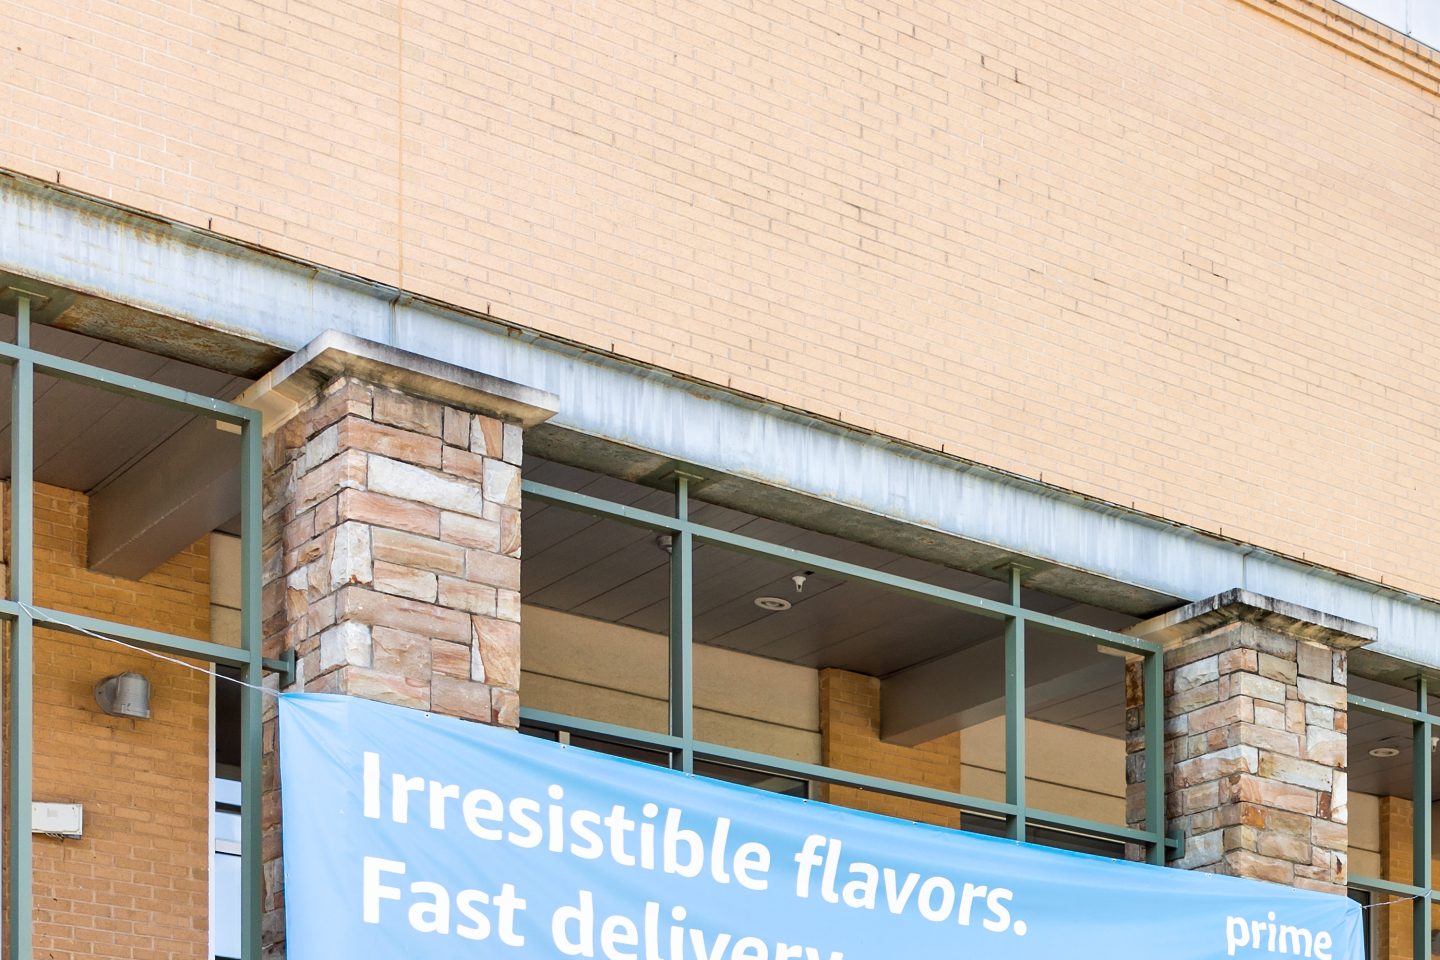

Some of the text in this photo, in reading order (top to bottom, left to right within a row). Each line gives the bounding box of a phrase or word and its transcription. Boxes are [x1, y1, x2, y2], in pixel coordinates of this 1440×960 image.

[361, 750, 1028, 936] Irresistible flavors.
[361, 855, 526, 947] Fast
[1226, 911, 1333, 960] prime
